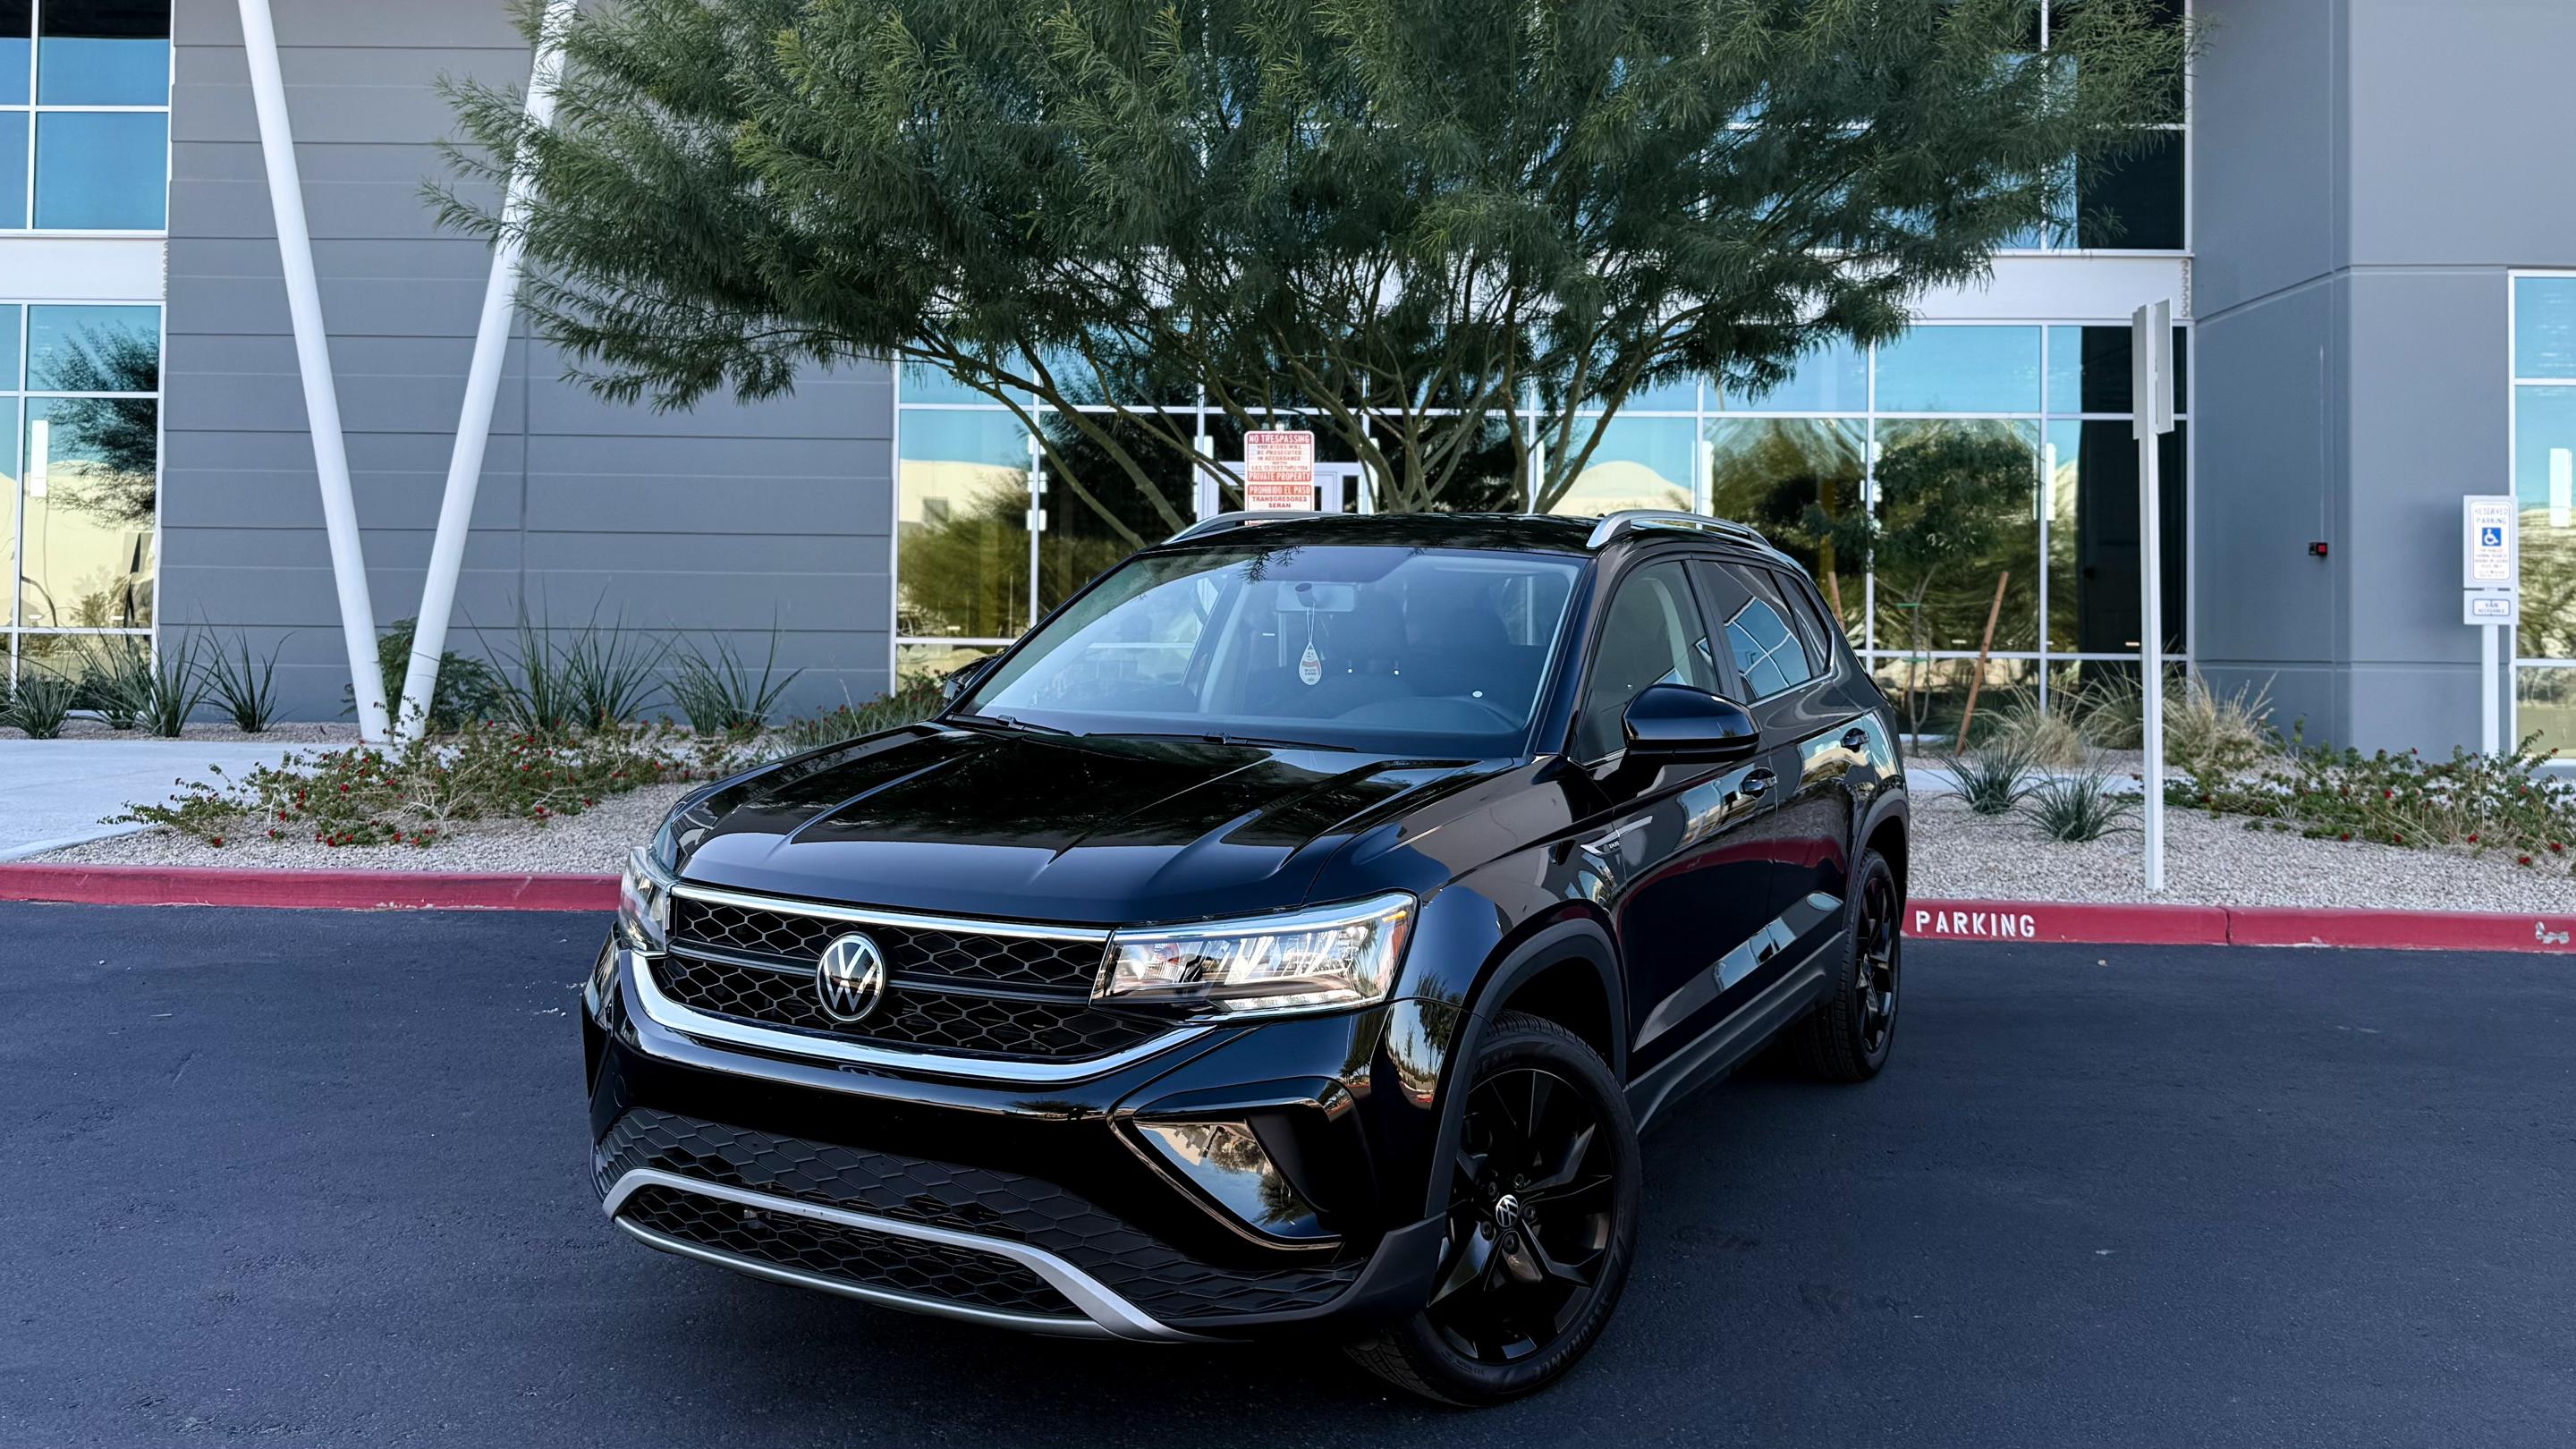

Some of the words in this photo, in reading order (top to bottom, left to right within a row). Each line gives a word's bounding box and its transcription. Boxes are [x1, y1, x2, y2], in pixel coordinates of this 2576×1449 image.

[1249, 435, 1259, 444] NO
[1262, 435, 1310, 444] TRESPASSING
[1249, 471, 1276, 480] PRIVATE
[1276, 471, 1310, 480] PROPERTY
[1249, 486, 1283, 494] PROHIBIDO
[1284, 486, 1291, 494] EL
[1293, 486, 1310, 494] PASO
[2475, 507, 2509, 515] RESERVED
[1915, 910, 2035, 937] PARKING
